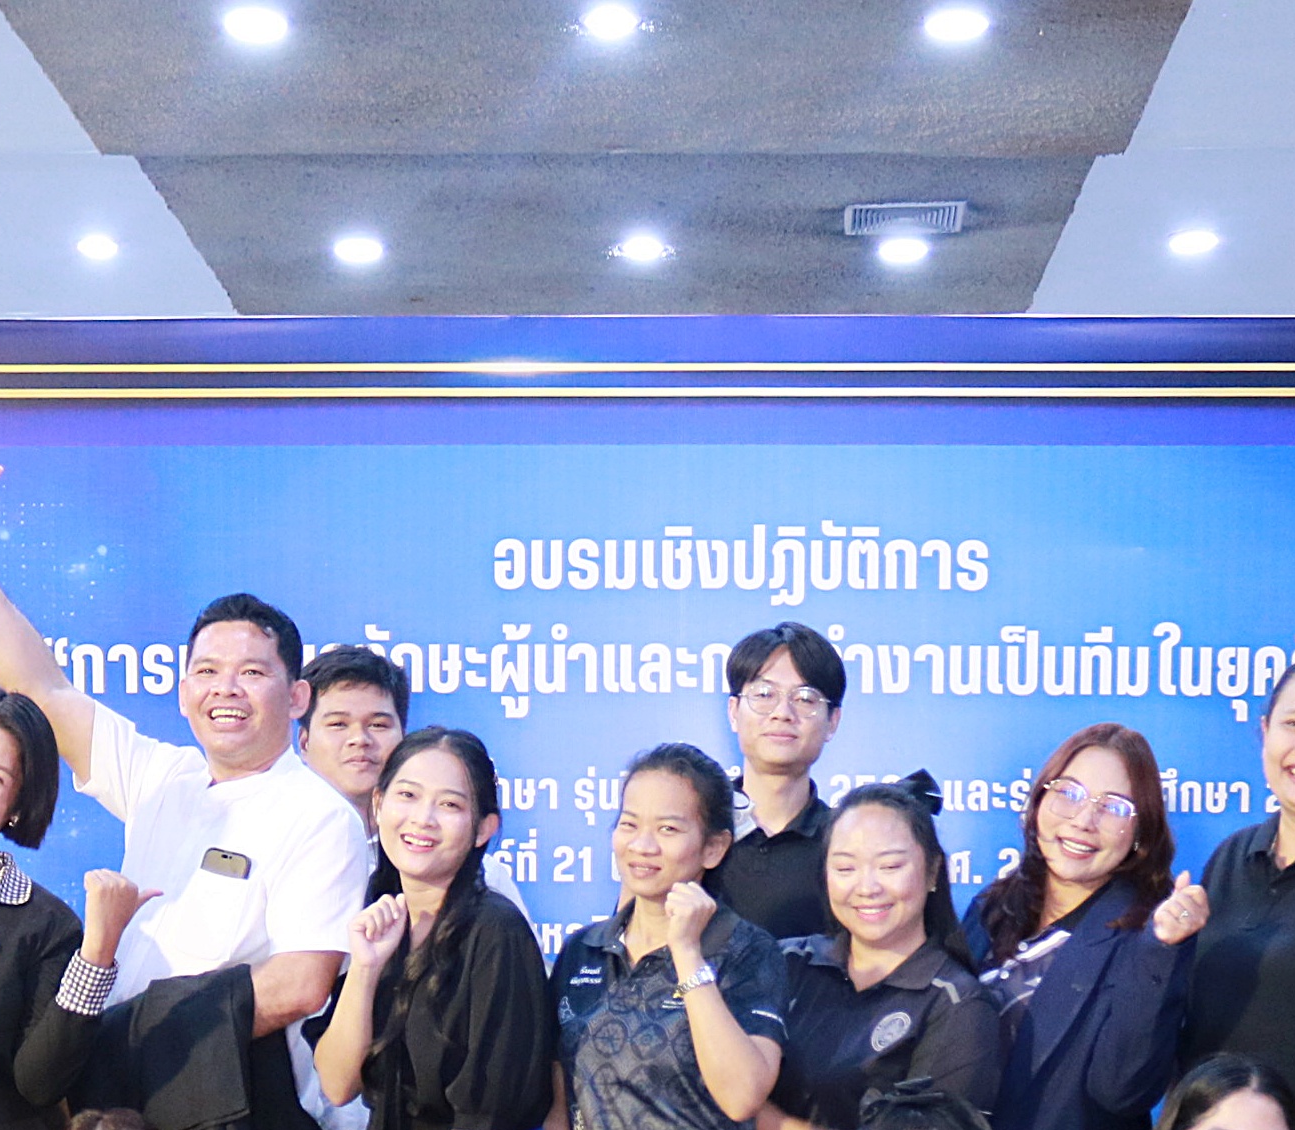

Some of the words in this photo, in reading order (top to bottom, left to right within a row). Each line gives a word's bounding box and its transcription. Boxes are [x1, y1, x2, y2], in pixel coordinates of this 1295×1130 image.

[493, 520, 990, 606] อบรมเชิงปฏิบัติการ
[553, 845, 592, 882] 21
